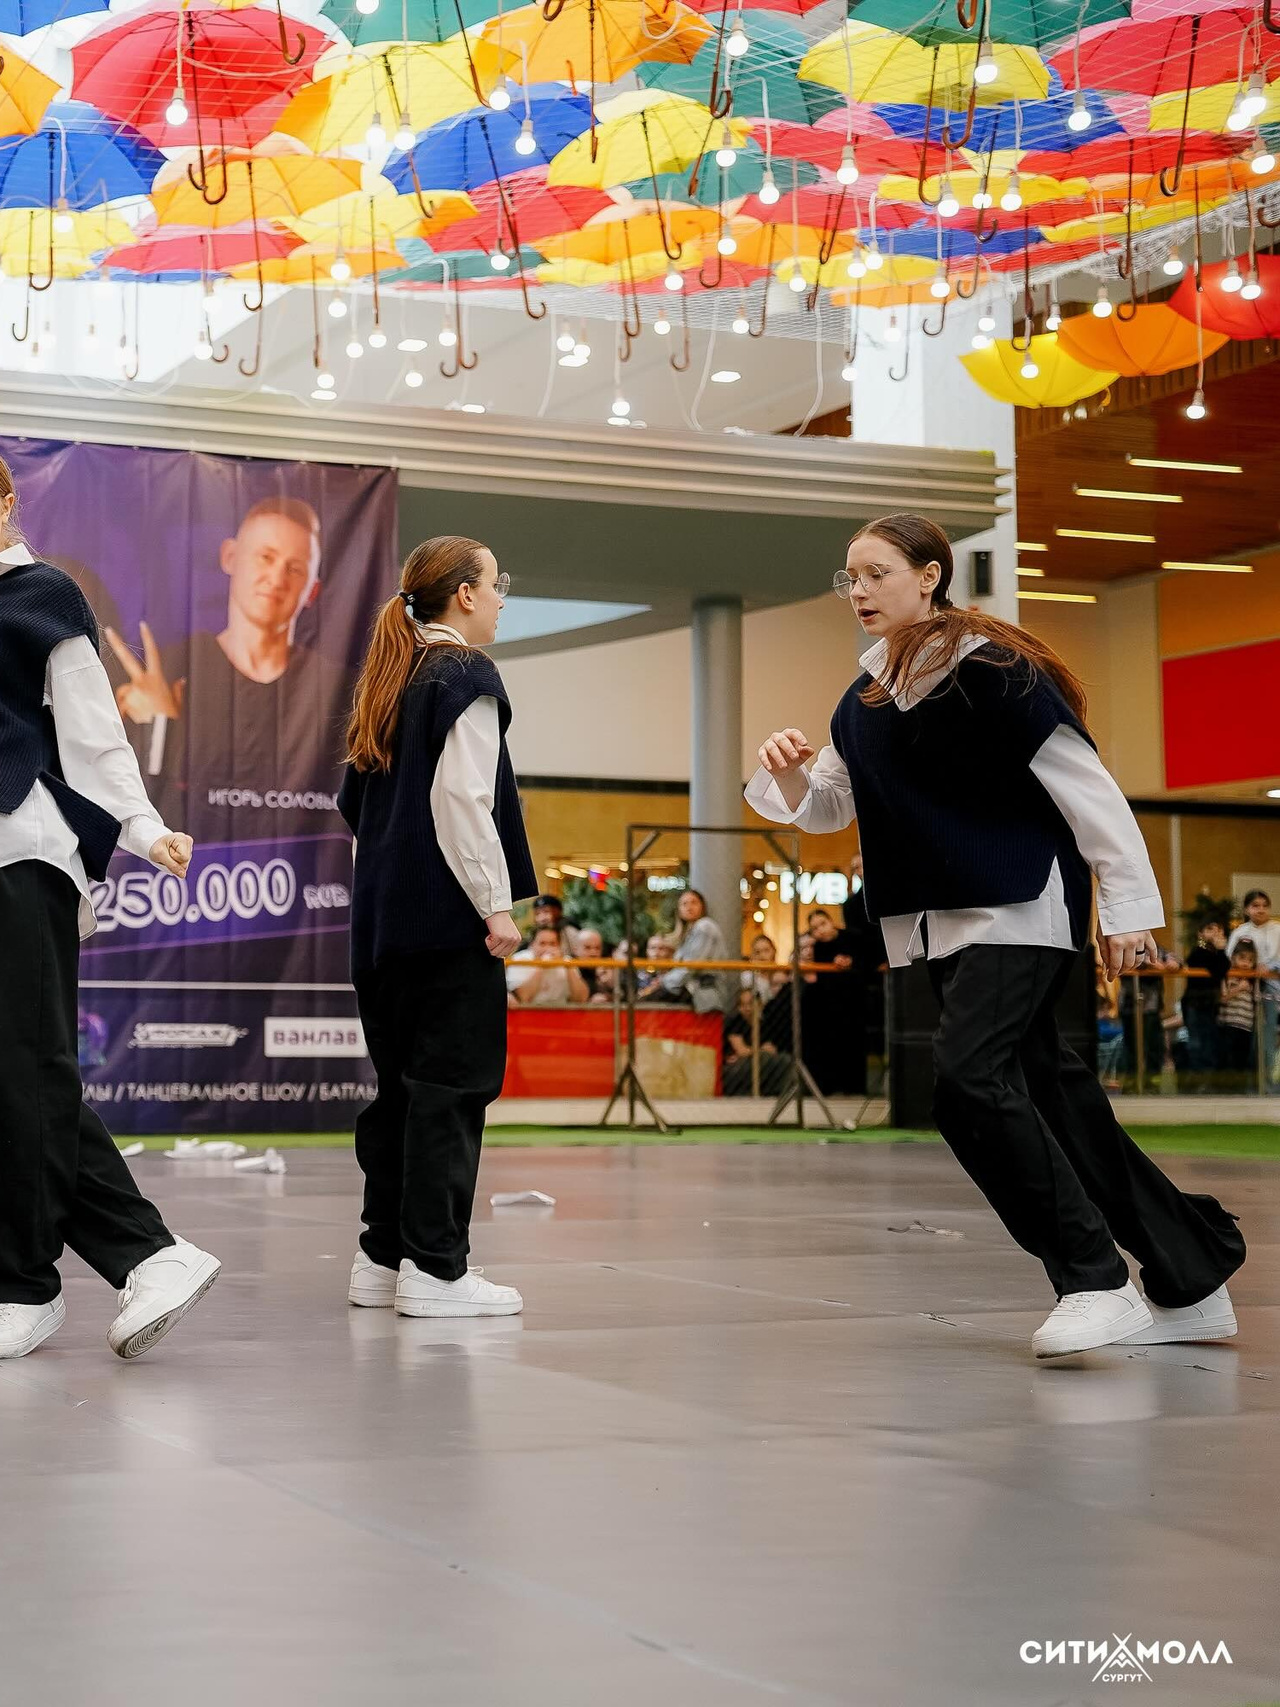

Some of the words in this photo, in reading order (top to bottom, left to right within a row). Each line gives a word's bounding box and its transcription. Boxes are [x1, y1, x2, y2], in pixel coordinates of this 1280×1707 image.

[208, 788, 264, 807] ИГОРЬ
[89, 857, 297, 933] 250.000
[127, 1082, 260, 1102] ТАНЦЕВАЛЬНОЕ
[261, 1082, 307, 1102] ШОУ
